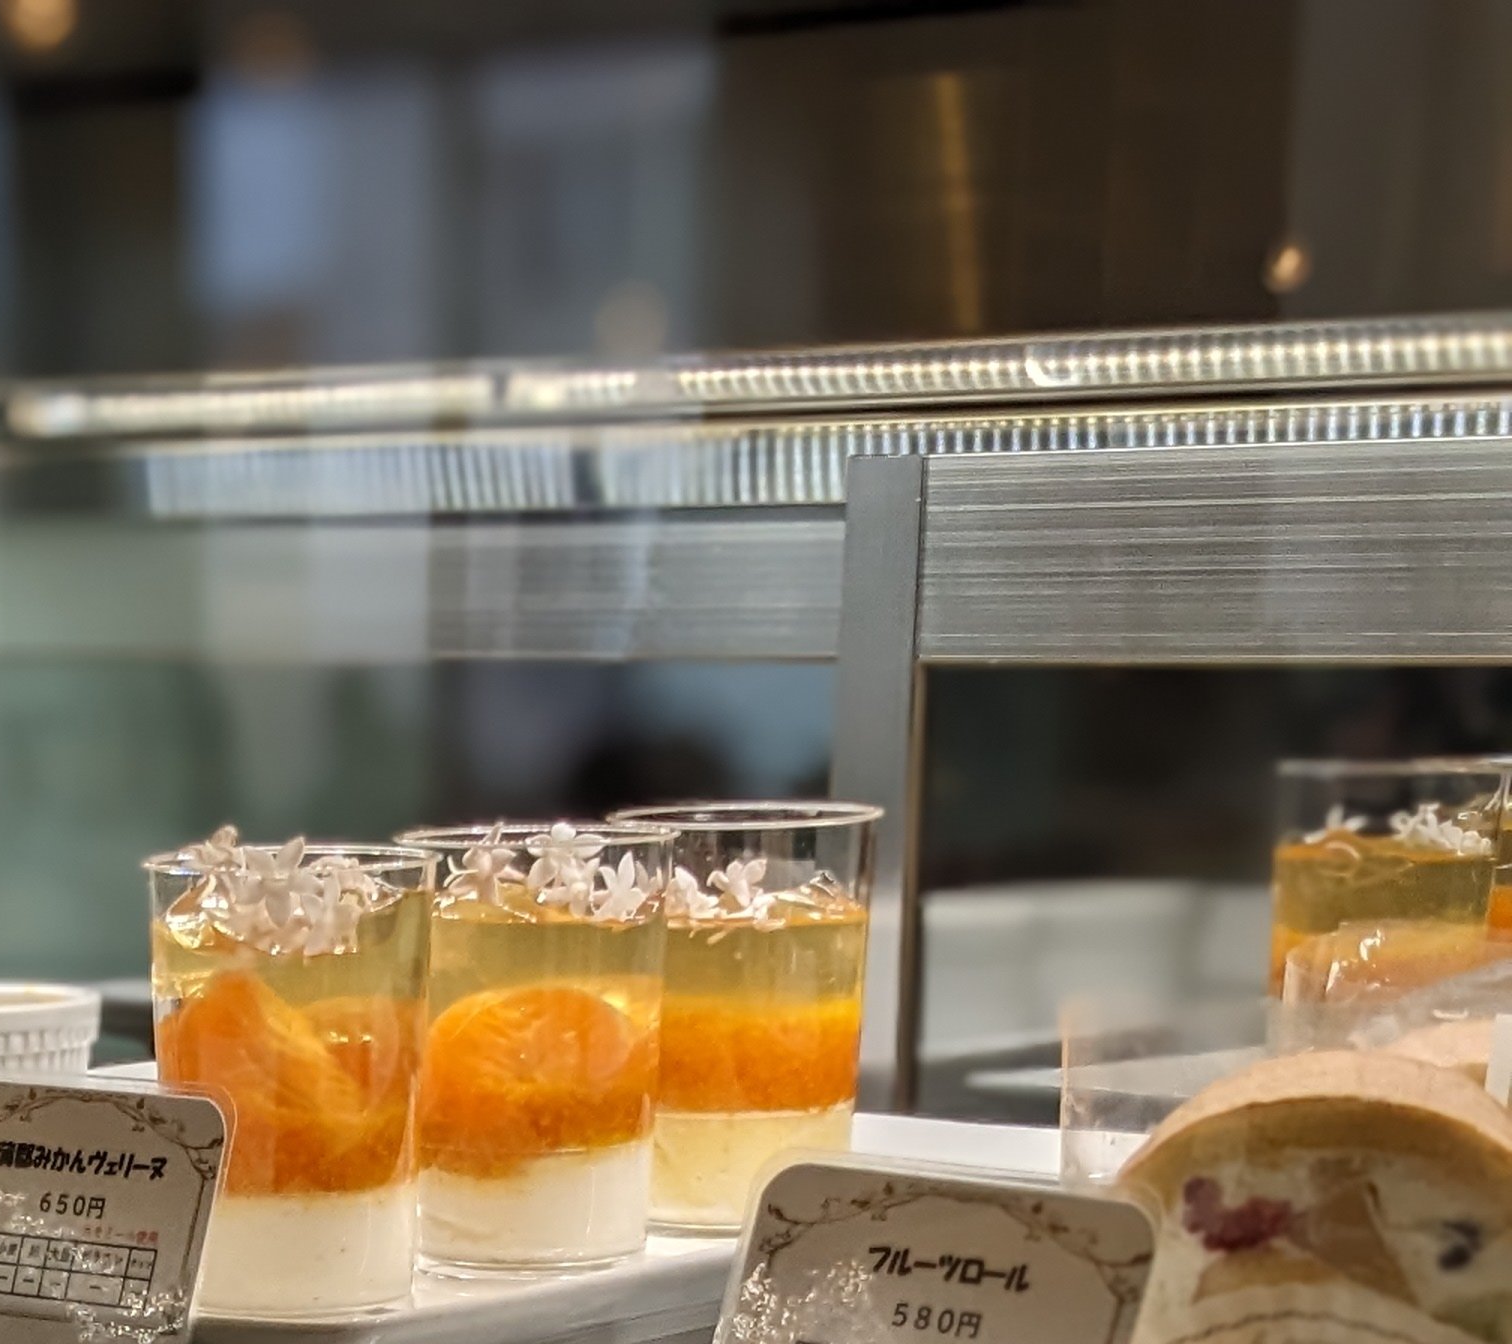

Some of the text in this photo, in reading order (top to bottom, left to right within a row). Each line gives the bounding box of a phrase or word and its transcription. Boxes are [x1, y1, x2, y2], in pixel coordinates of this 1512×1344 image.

[39, 1191, 106, 1219] 650円
[868, 1245, 1031, 1292] フルーツロール
[891, 1301, 984, 1339] 580円
